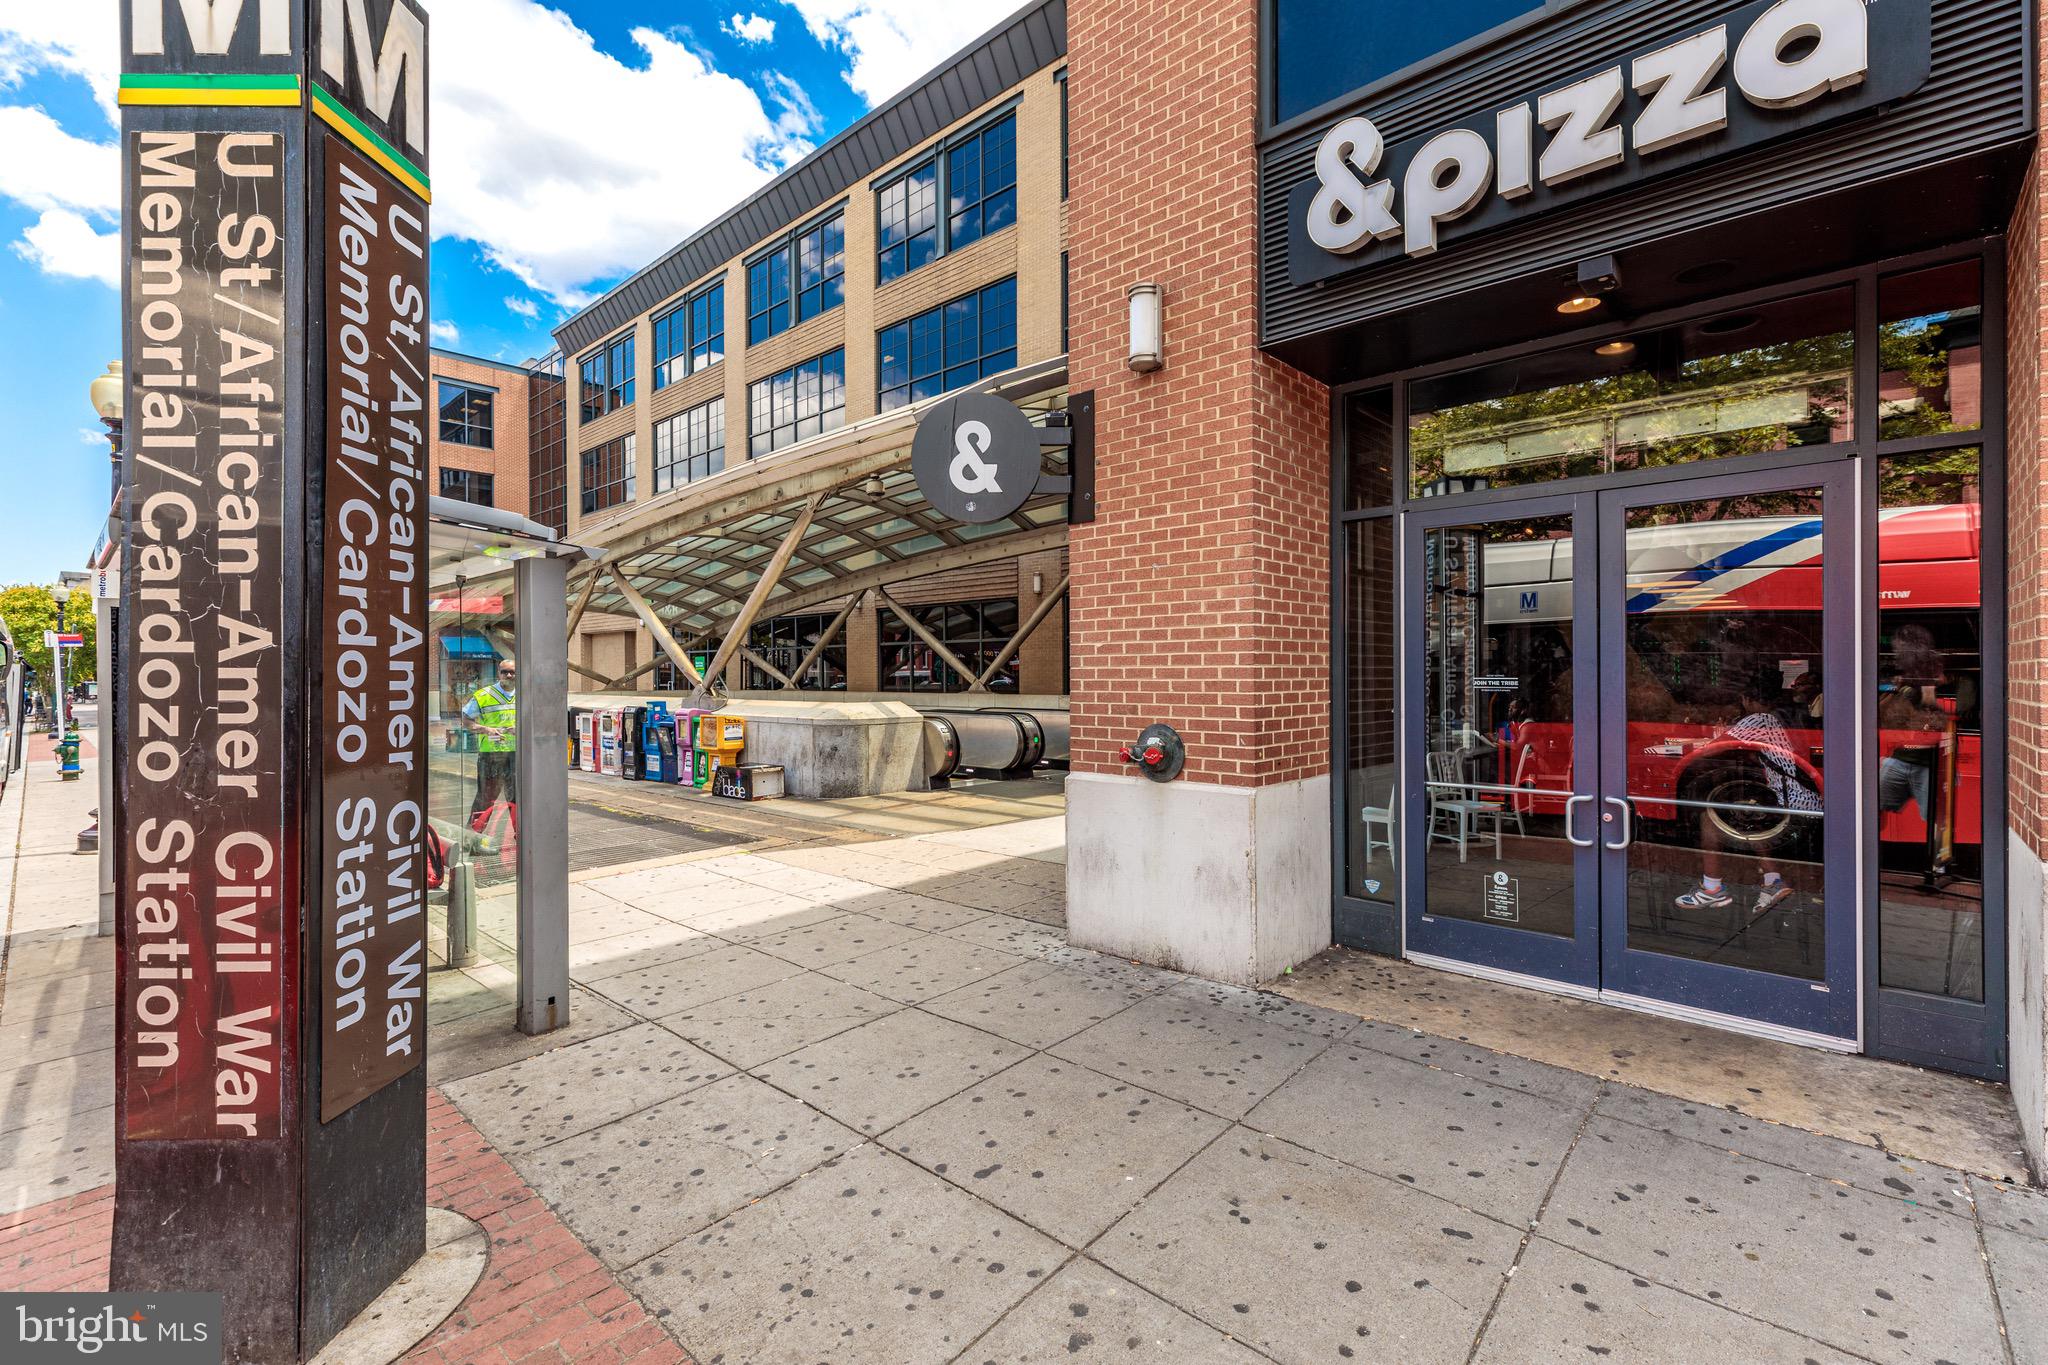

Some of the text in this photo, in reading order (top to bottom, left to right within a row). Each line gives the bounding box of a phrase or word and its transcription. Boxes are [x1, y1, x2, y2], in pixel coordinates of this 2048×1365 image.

[216, 133, 274, 178] U
[1307, 0, 1868, 257] &pizza
[388, 204, 423, 258] U
[949, 420, 1003, 494] &
[135, 132, 203, 1068] Memorial/Cardozo Station
[335, 162, 380, 1032] Memorial/Cardozo Station
[214, 831, 274, 973] Civil
[386, 800, 421, 924] Civil
[386, 938, 421, 1058] War
[215, 1007, 273, 1137] War
